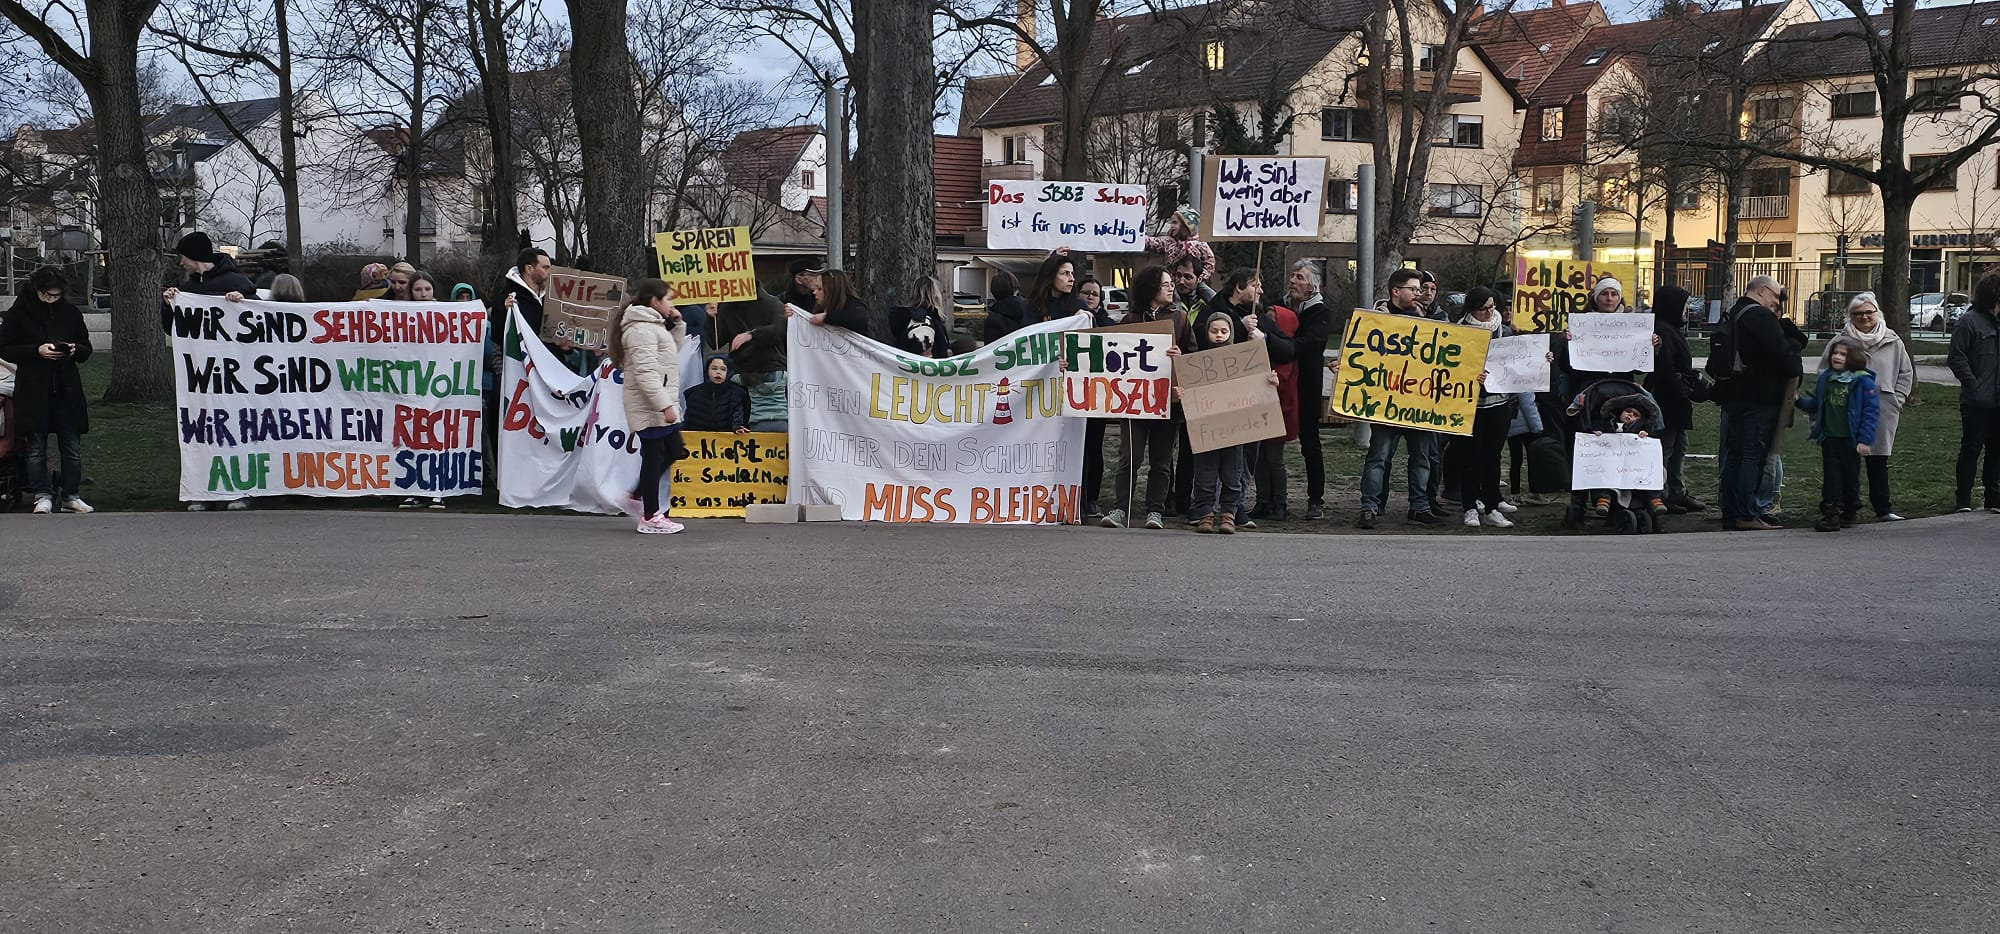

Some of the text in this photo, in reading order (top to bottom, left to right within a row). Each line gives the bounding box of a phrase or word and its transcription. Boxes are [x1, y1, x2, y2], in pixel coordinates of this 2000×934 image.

[1220, 158, 1252, 184] Wir
[989, 183, 1025, 204] Das
[1038, 183, 1084, 202] SBBZ
[1219, 183, 1312, 207] wenig aber
[1001, 211, 1022, 229] ist
[1031, 212, 1051, 232] für
[1060, 222, 1086, 234] uns
[1226, 204, 1300, 231] Wertvoll
[672, 227, 736, 251] SPAREN
[661, 253, 703, 275] heißt
[1516, 255, 1612, 290] Ich Lieb
[553, 276, 597, 301] Wir
[556, 321, 608, 350] SCHUL
[1532, 311, 1568, 333] SBB
[993, 332, 1060, 370] SEHE
[1066, 334, 1158, 375] Hört
[1346, 317, 1461, 367] Lasst die
[1182, 347, 1264, 384] SBBZ
[1344, 351, 1473, 403] Schule offen!
[789, 381, 819, 409] IST
[869, 373, 991, 424] LEUCHT
[1342, 386, 1381, 418] Wir
[239, 407, 332, 447] HABEN
[392, 404, 481, 451] RECHT
[803, 427, 882, 469] UNTER
[894, 440, 947, 471] DEN
[208, 450, 482, 492] AUF UNSERE SCHULE
[673, 469, 692, 483] die
[671, 496, 686, 507] es
[696, 496, 721, 507] uns
[863, 483, 956, 523] MUSS
